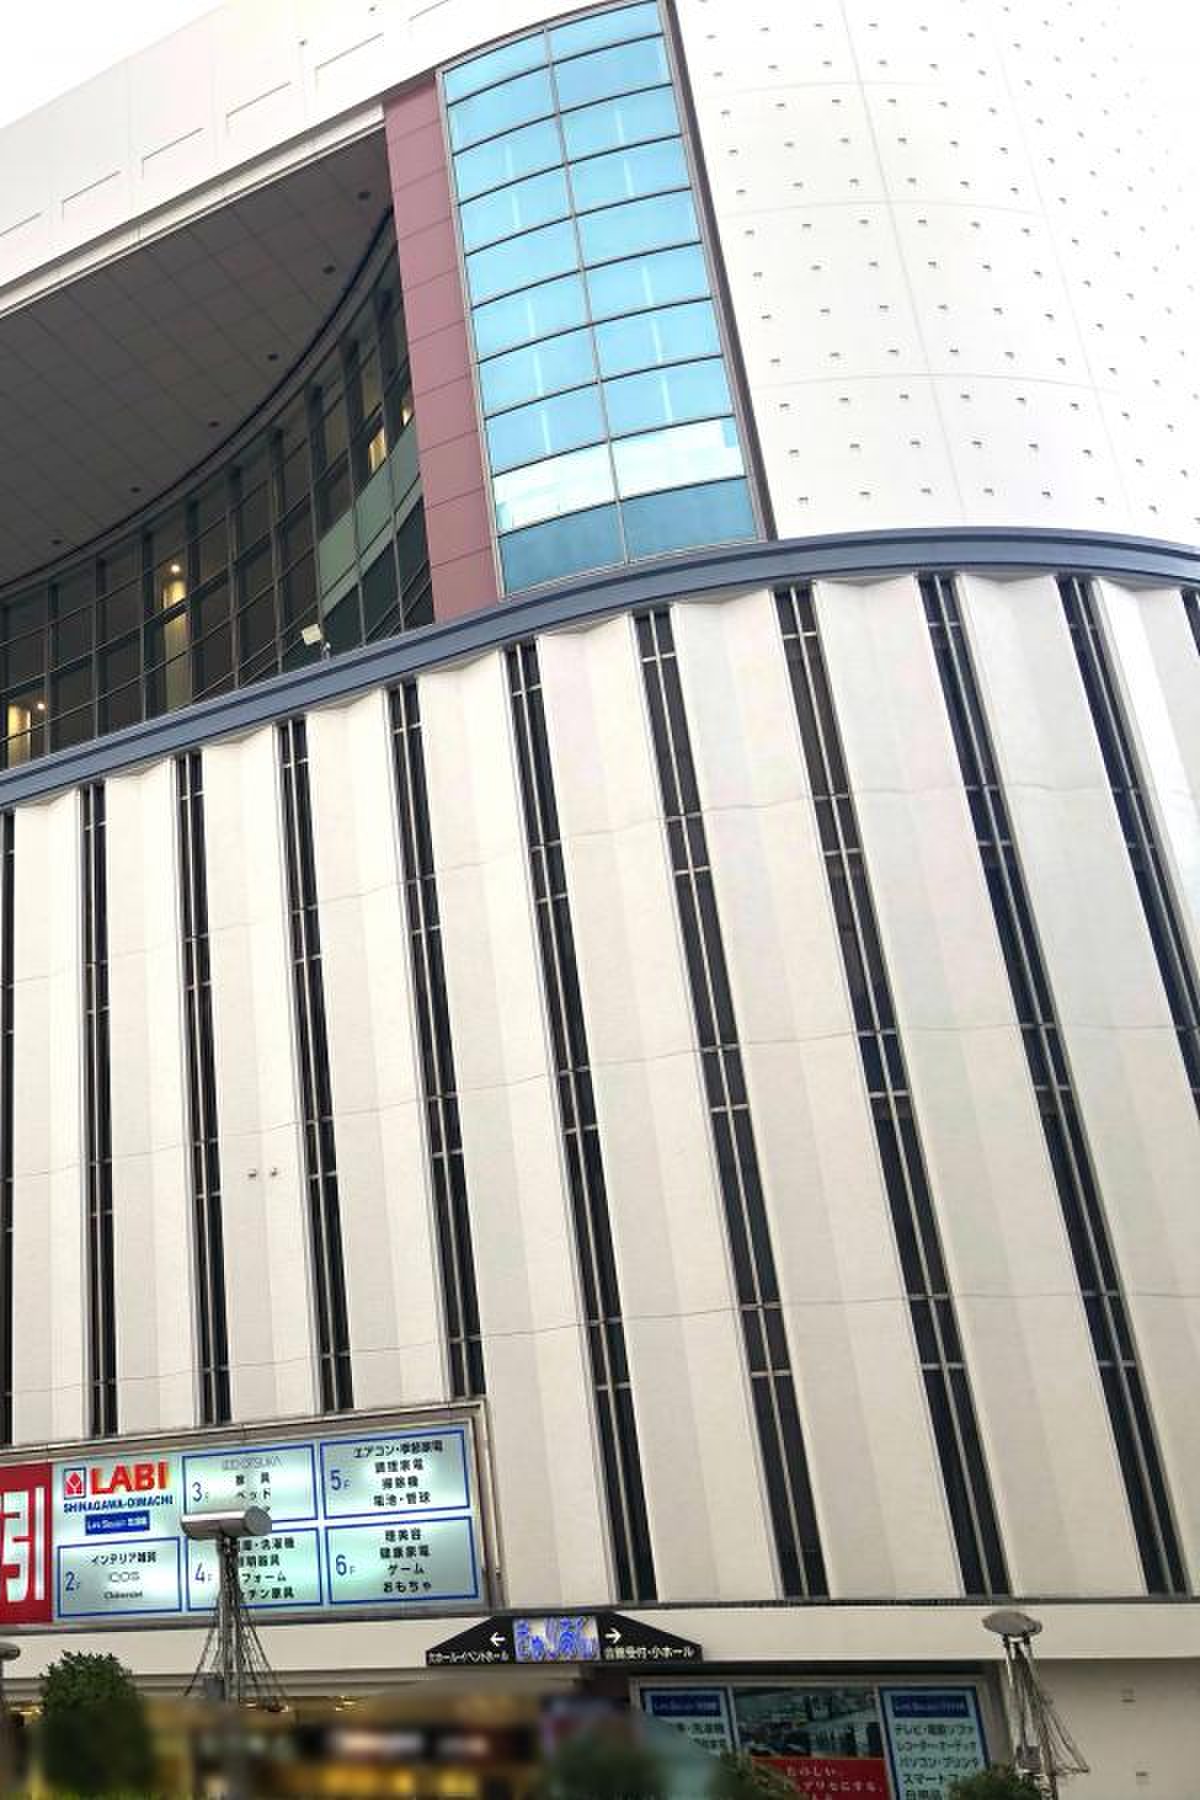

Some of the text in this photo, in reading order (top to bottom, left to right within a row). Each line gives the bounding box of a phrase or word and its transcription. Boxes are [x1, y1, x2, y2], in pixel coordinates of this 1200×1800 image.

[90, 1461, 170, 1495] LABI
[91, 1552, 157, 1567] インテリア雑貨
[387, 1563, 425, 1577] ゲーム
[384, 1581, 432, 1594] おもちゃ
